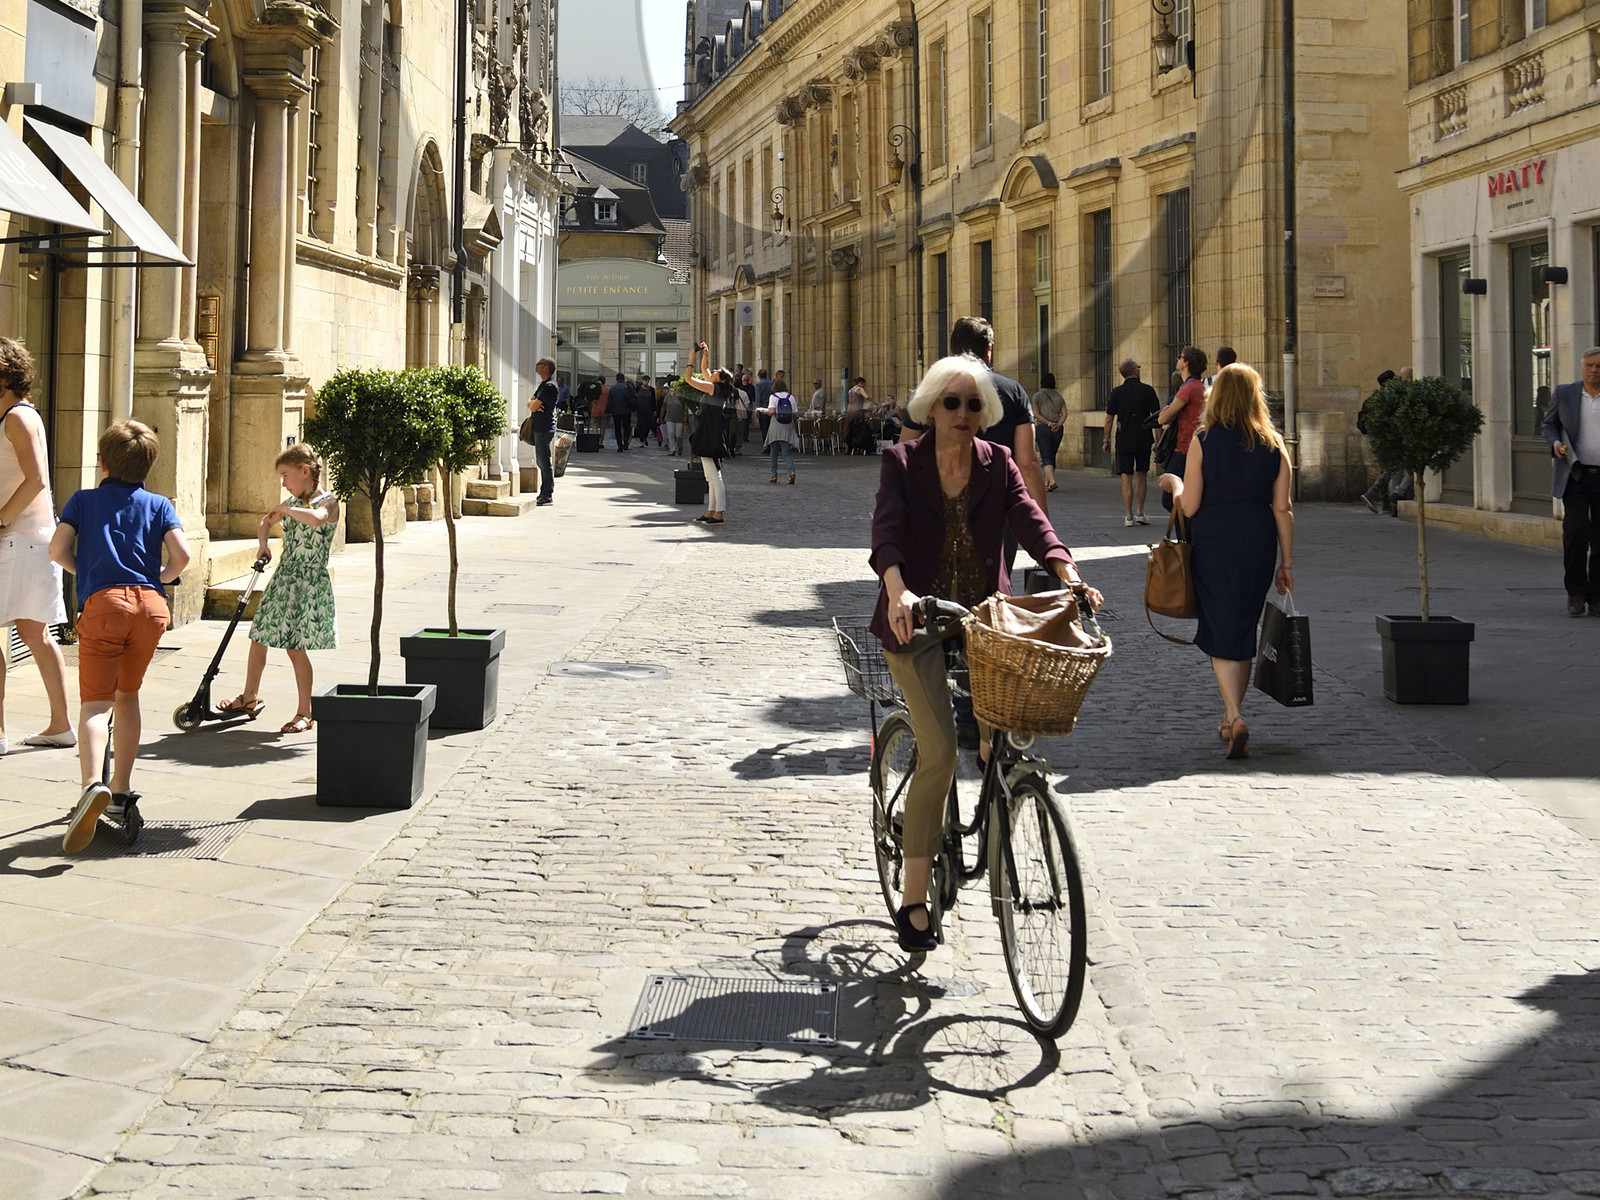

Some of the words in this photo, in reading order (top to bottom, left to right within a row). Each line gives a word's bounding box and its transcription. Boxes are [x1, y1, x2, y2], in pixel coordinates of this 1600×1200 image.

[1488, 160, 1546, 198] MATY
[566, 286, 598, 294] PETITE
[603, 286, 649, 294] ENFANCE
